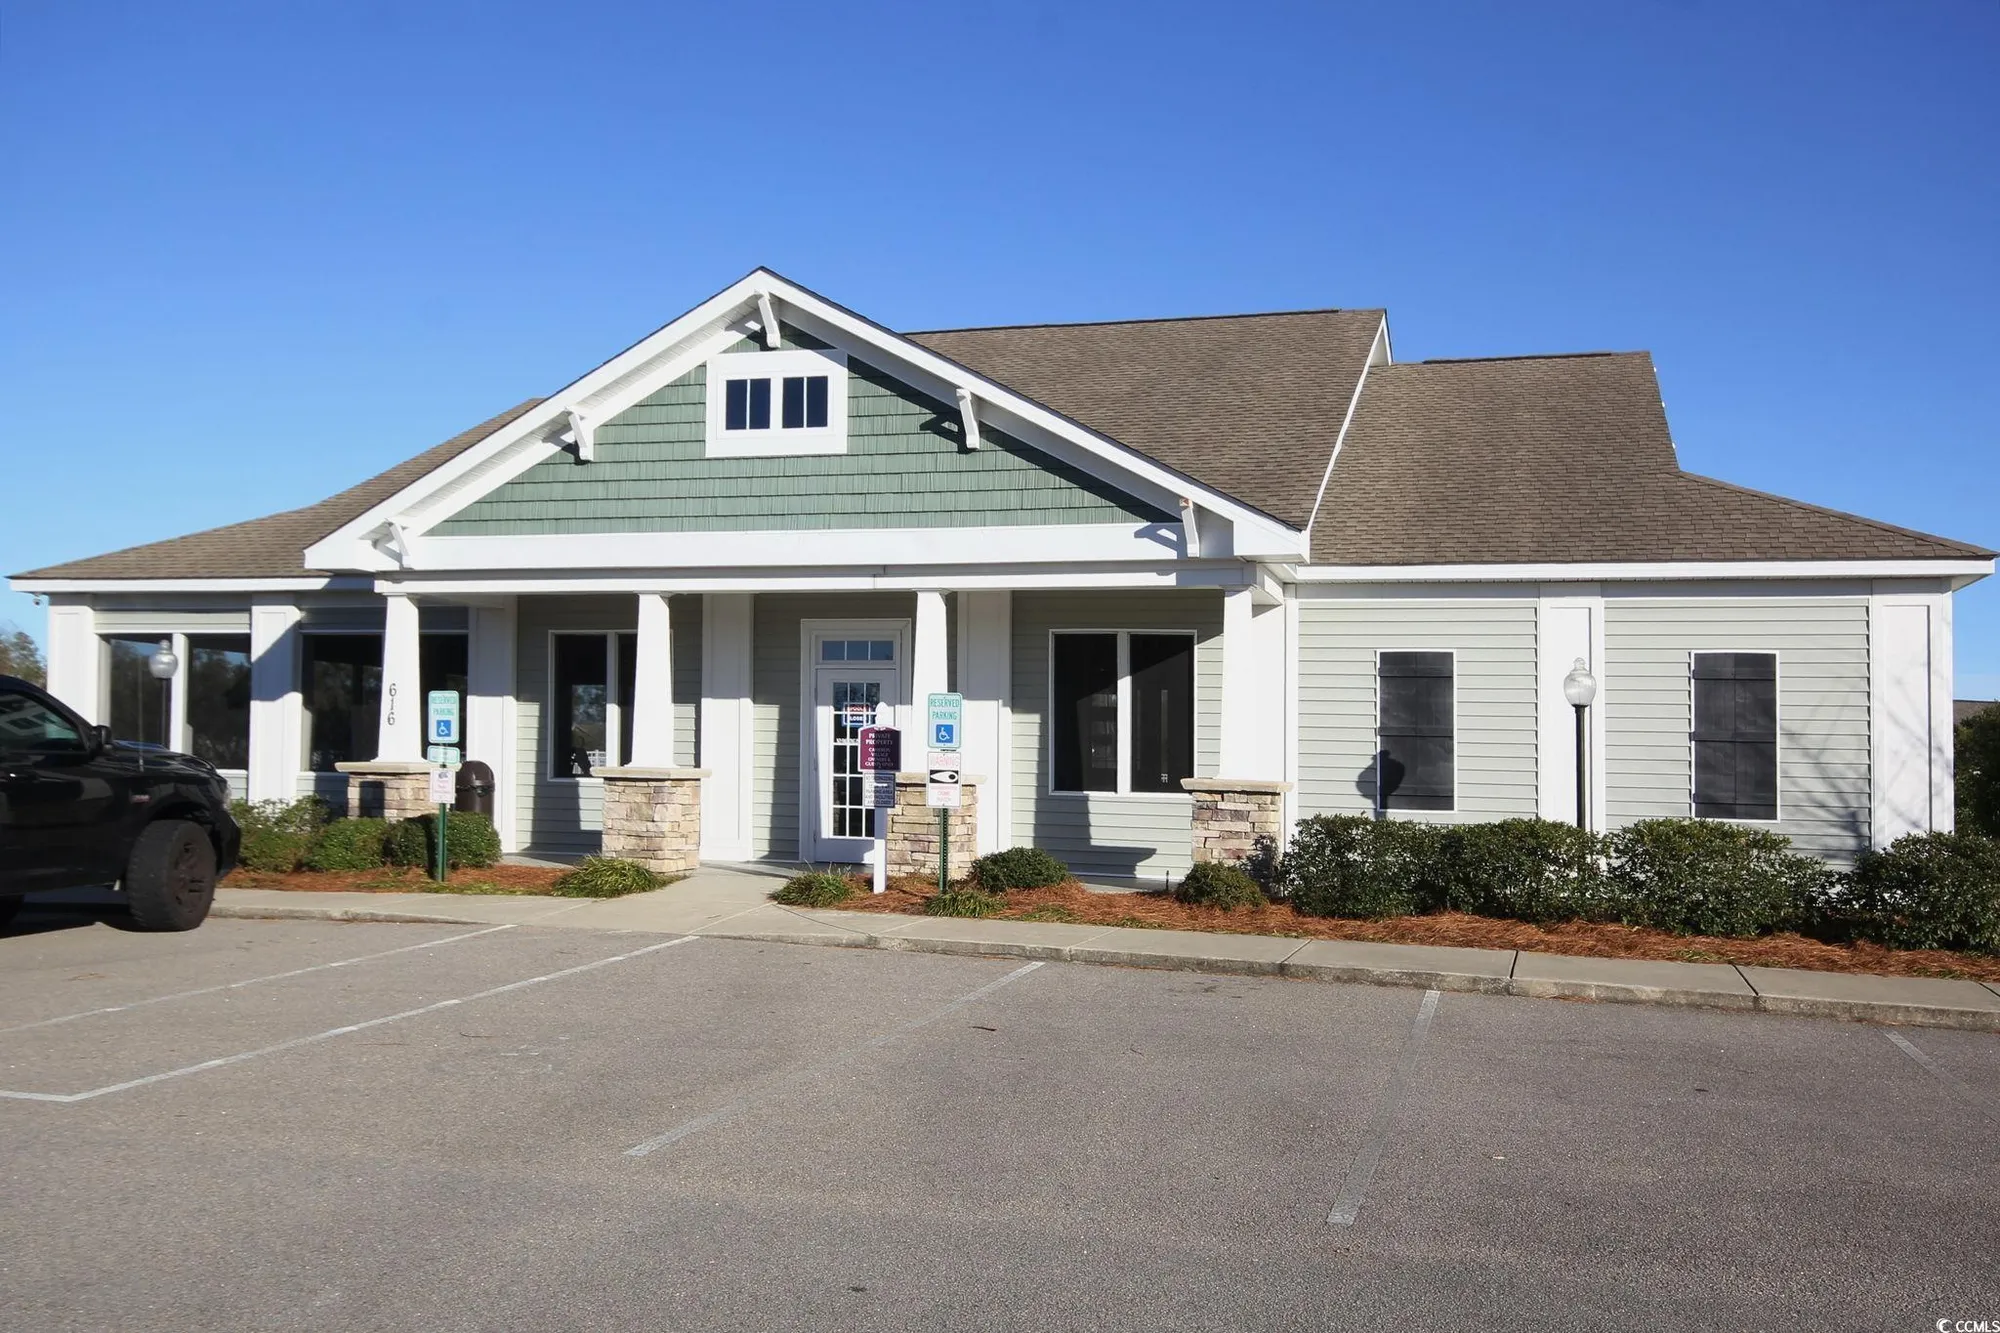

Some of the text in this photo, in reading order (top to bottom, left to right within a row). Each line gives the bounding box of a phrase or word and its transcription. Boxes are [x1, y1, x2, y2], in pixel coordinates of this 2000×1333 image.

[387, 683, 397, 726] 616
[930, 699, 960, 708] RESERVED
[932, 711, 958, 720] PARKING
